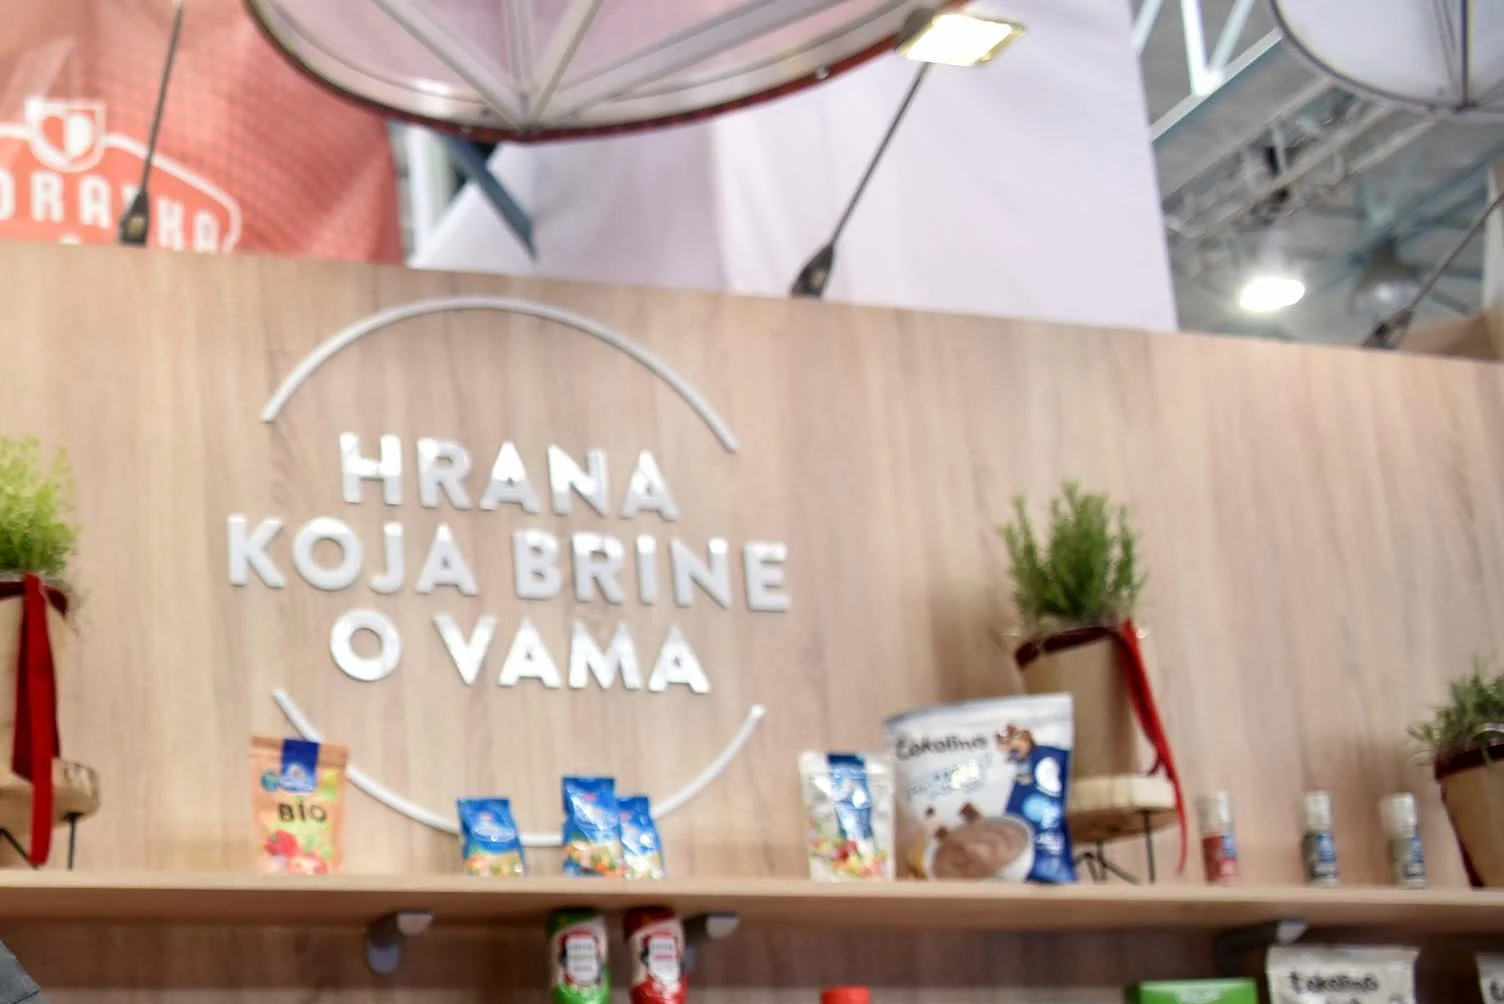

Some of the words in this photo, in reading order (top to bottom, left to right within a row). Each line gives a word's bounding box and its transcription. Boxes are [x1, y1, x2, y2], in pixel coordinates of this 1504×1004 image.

[338, 432, 679, 521] HRANA
[227, 514, 479, 596] KOJA
[513, 527, 792, 612] BRINE
[329, 608, 402, 682] O
[432, 614, 710, 694] VAMA
